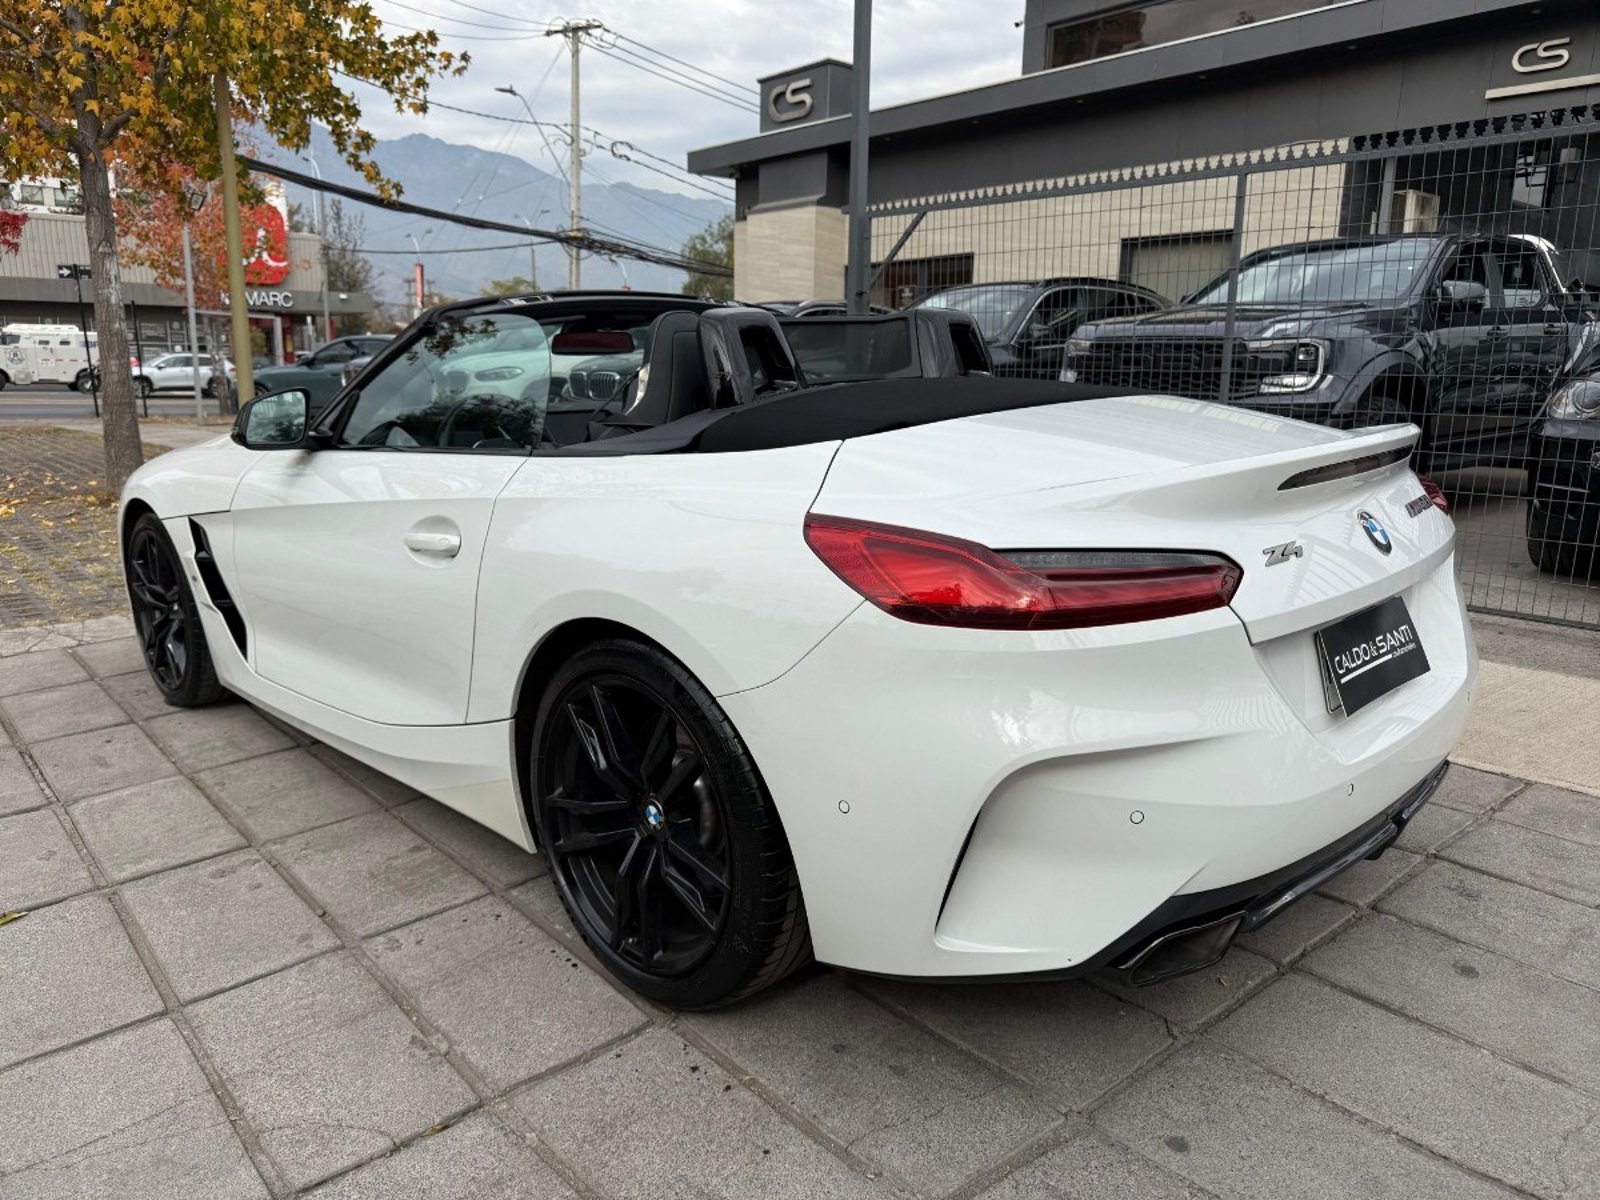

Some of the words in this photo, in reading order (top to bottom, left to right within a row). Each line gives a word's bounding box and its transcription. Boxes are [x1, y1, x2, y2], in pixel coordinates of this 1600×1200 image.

[1511, 37, 1570, 73] CS
[768, 78, 812, 122] CS
[1262, 540, 1303, 567] Z4
